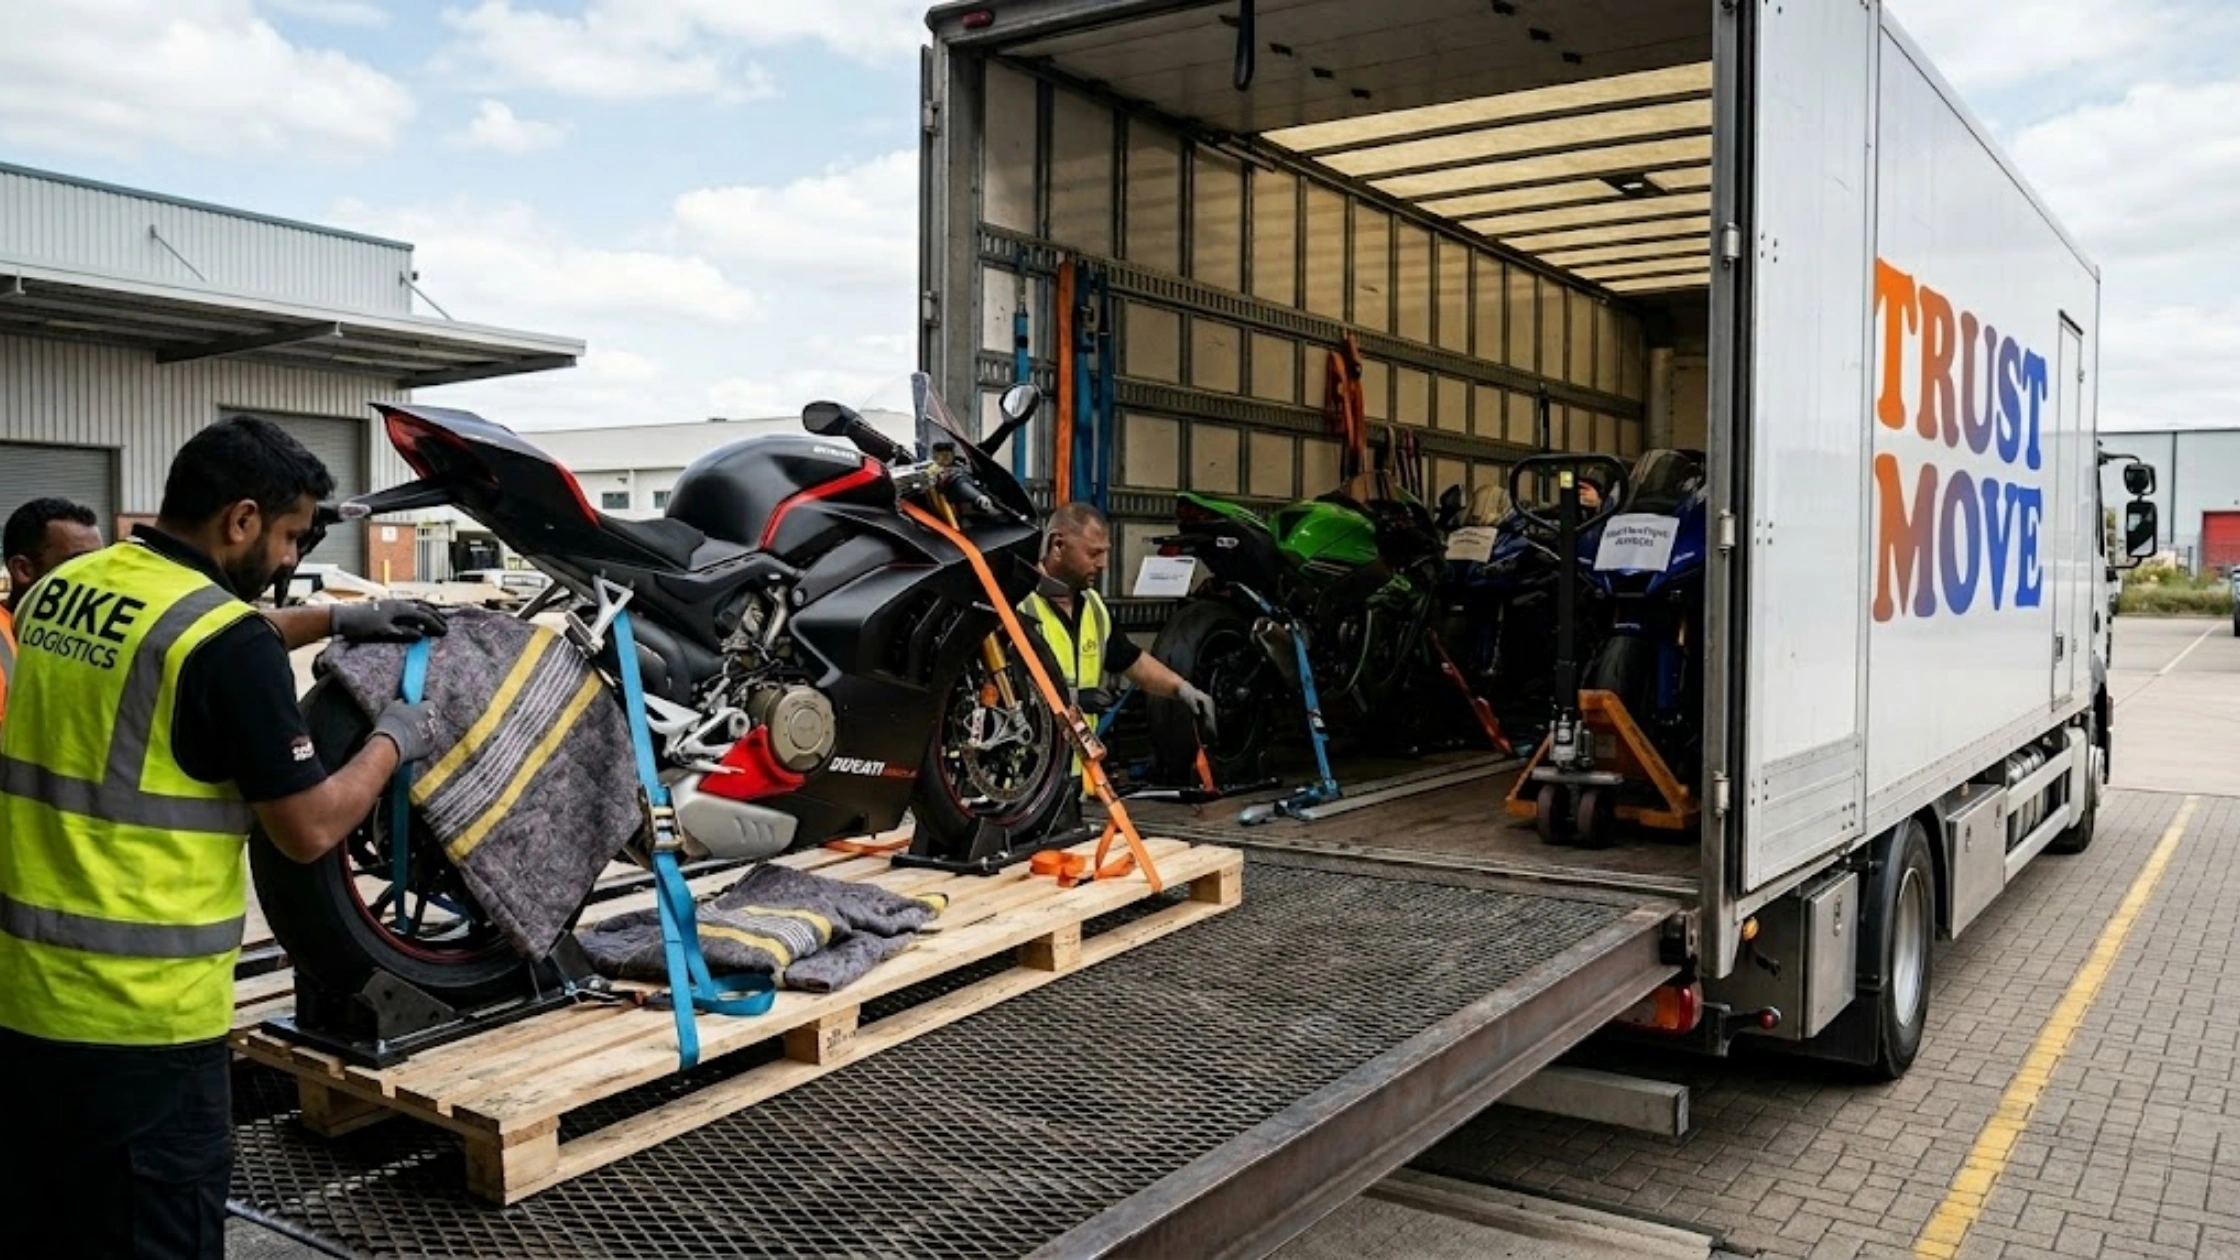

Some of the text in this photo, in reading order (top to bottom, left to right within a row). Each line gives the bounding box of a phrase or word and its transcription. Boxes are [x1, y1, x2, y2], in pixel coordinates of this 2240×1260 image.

[1874, 258, 2047, 470] TRUST
[1873, 454, 2042, 622] MOVE
[22, 625, 118, 669] LOGISTICS
[32, 577, 146, 643] BIKE
